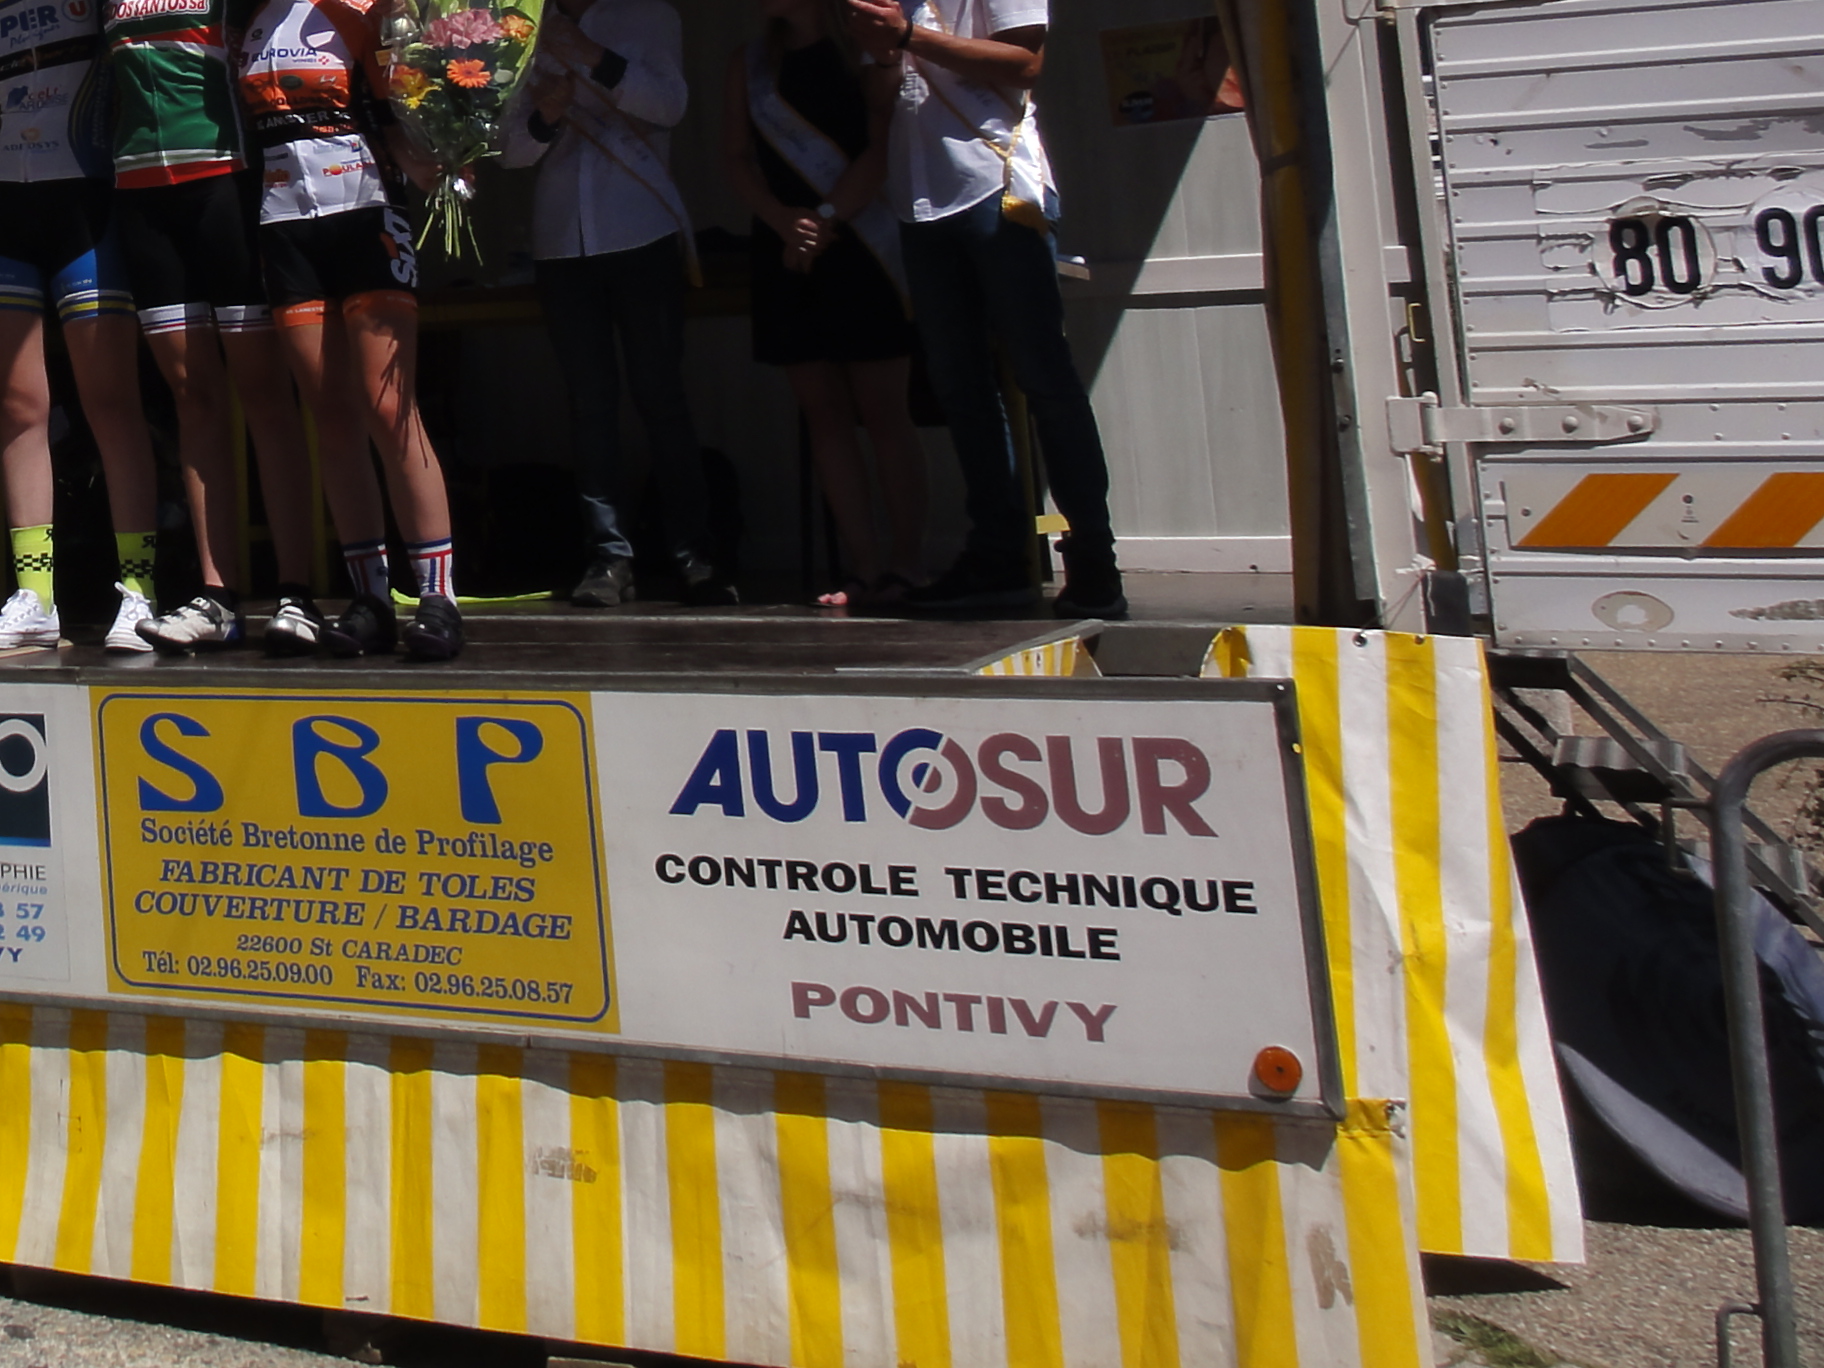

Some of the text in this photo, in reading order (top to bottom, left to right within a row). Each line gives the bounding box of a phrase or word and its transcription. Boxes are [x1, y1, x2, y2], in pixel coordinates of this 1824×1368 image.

[1609, 216, 1701, 297] 80
[669, 728, 1220, 838] AUTOSUR
[140, 818, 554, 869] Société Bretonne de Profilage
[158, 858, 537, 903] FABRICANT DE TOLES
[654, 852, 1258, 916] CONTROLE TECHNIQUE
[16, 902, 44, 920] 57
[16, 924, 46, 943] 49
[133, 891, 367, 927] COUVERTURE
[395, 906, 574, 941] BARDAGE
[782, 908, 1121, 962] AUTOMOBILE
[236, 934, 464, 967] 22600 St CARADEC
[142, 949, 574, 1005] Tél: 02.96.25.09.00 Fax: 02.96.25.08.57
[790, 980, 1118, 1044] PONTIVY
